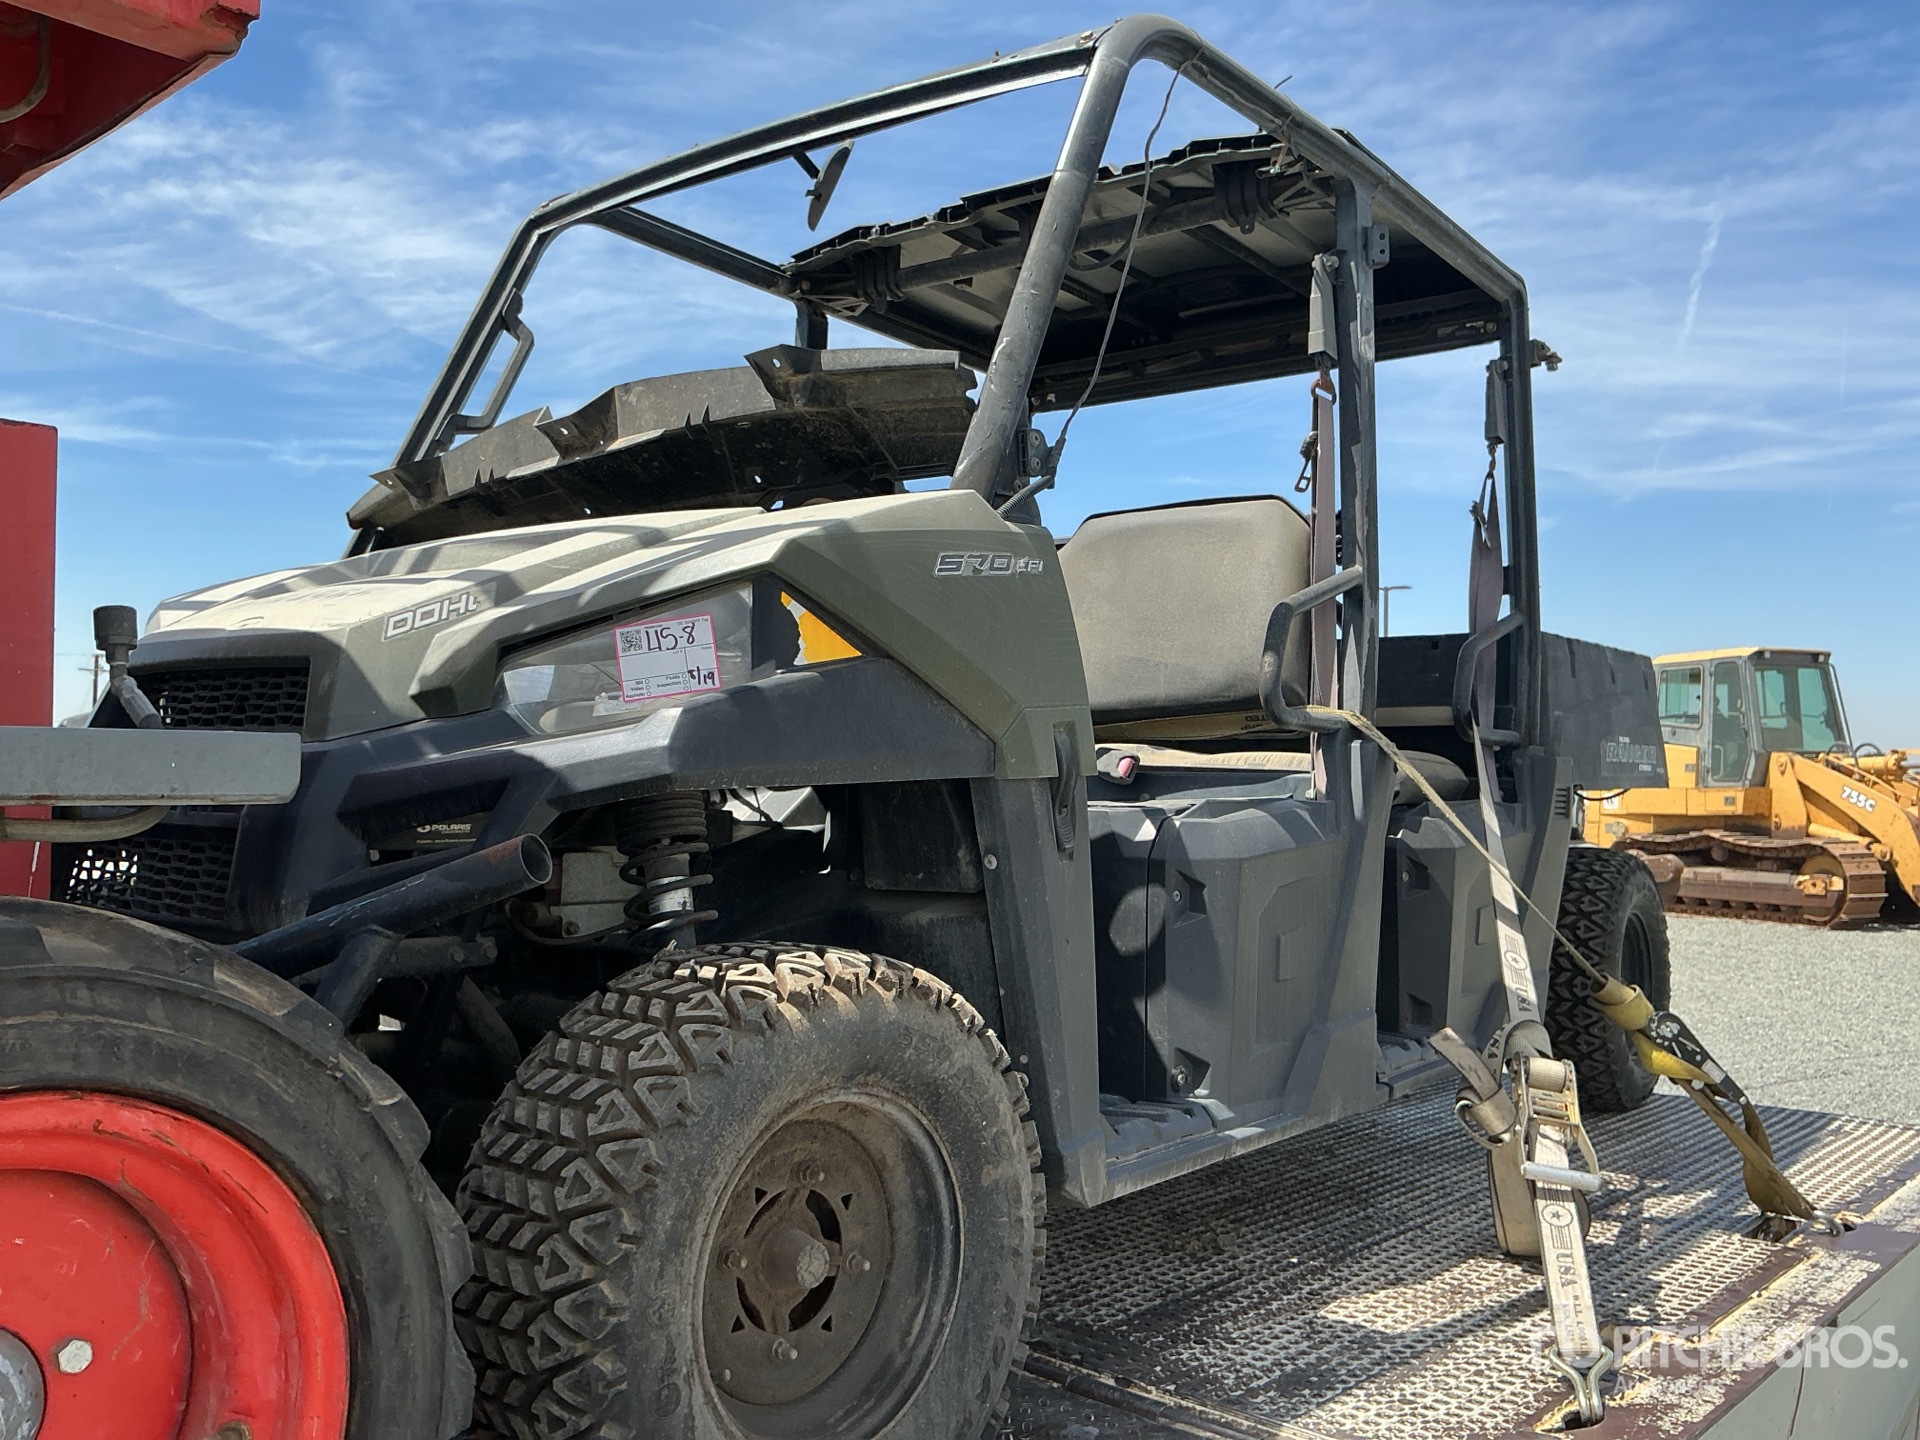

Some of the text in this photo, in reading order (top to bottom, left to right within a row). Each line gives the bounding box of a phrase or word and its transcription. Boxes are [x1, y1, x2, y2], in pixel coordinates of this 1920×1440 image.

[935, 552, 1014, 577] 570
[1605, 742, 1657, 764] RANGER
[1841, 785, 1876, 812] 755C
[1515, 988, 1532, 1012] USA
[1556, 1252, 1579, 1289] USA
